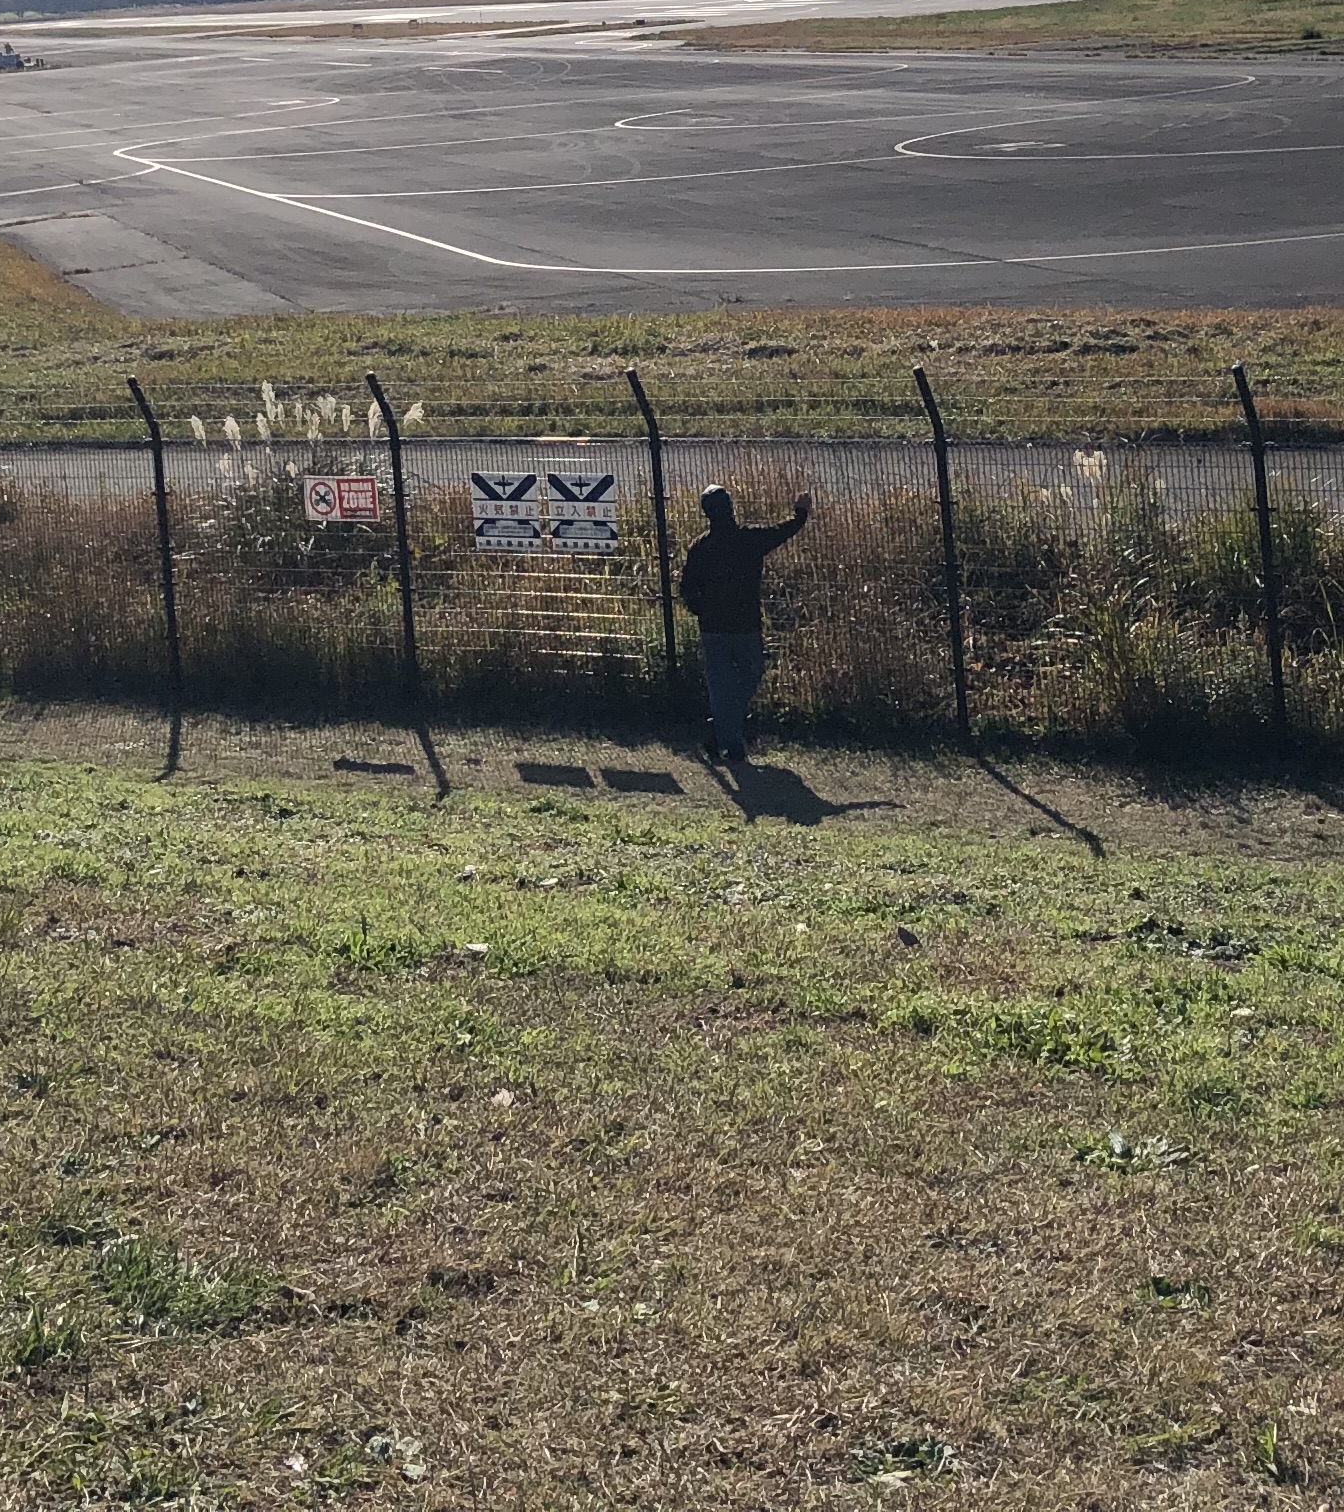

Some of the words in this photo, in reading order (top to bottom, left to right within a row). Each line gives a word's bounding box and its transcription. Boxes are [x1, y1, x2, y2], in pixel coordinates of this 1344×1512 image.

[341, 491, 374, 508] ZONE
[478, 504, 535, 517] 火気禁止
[554, 505, 613, 518] 立入禁止
